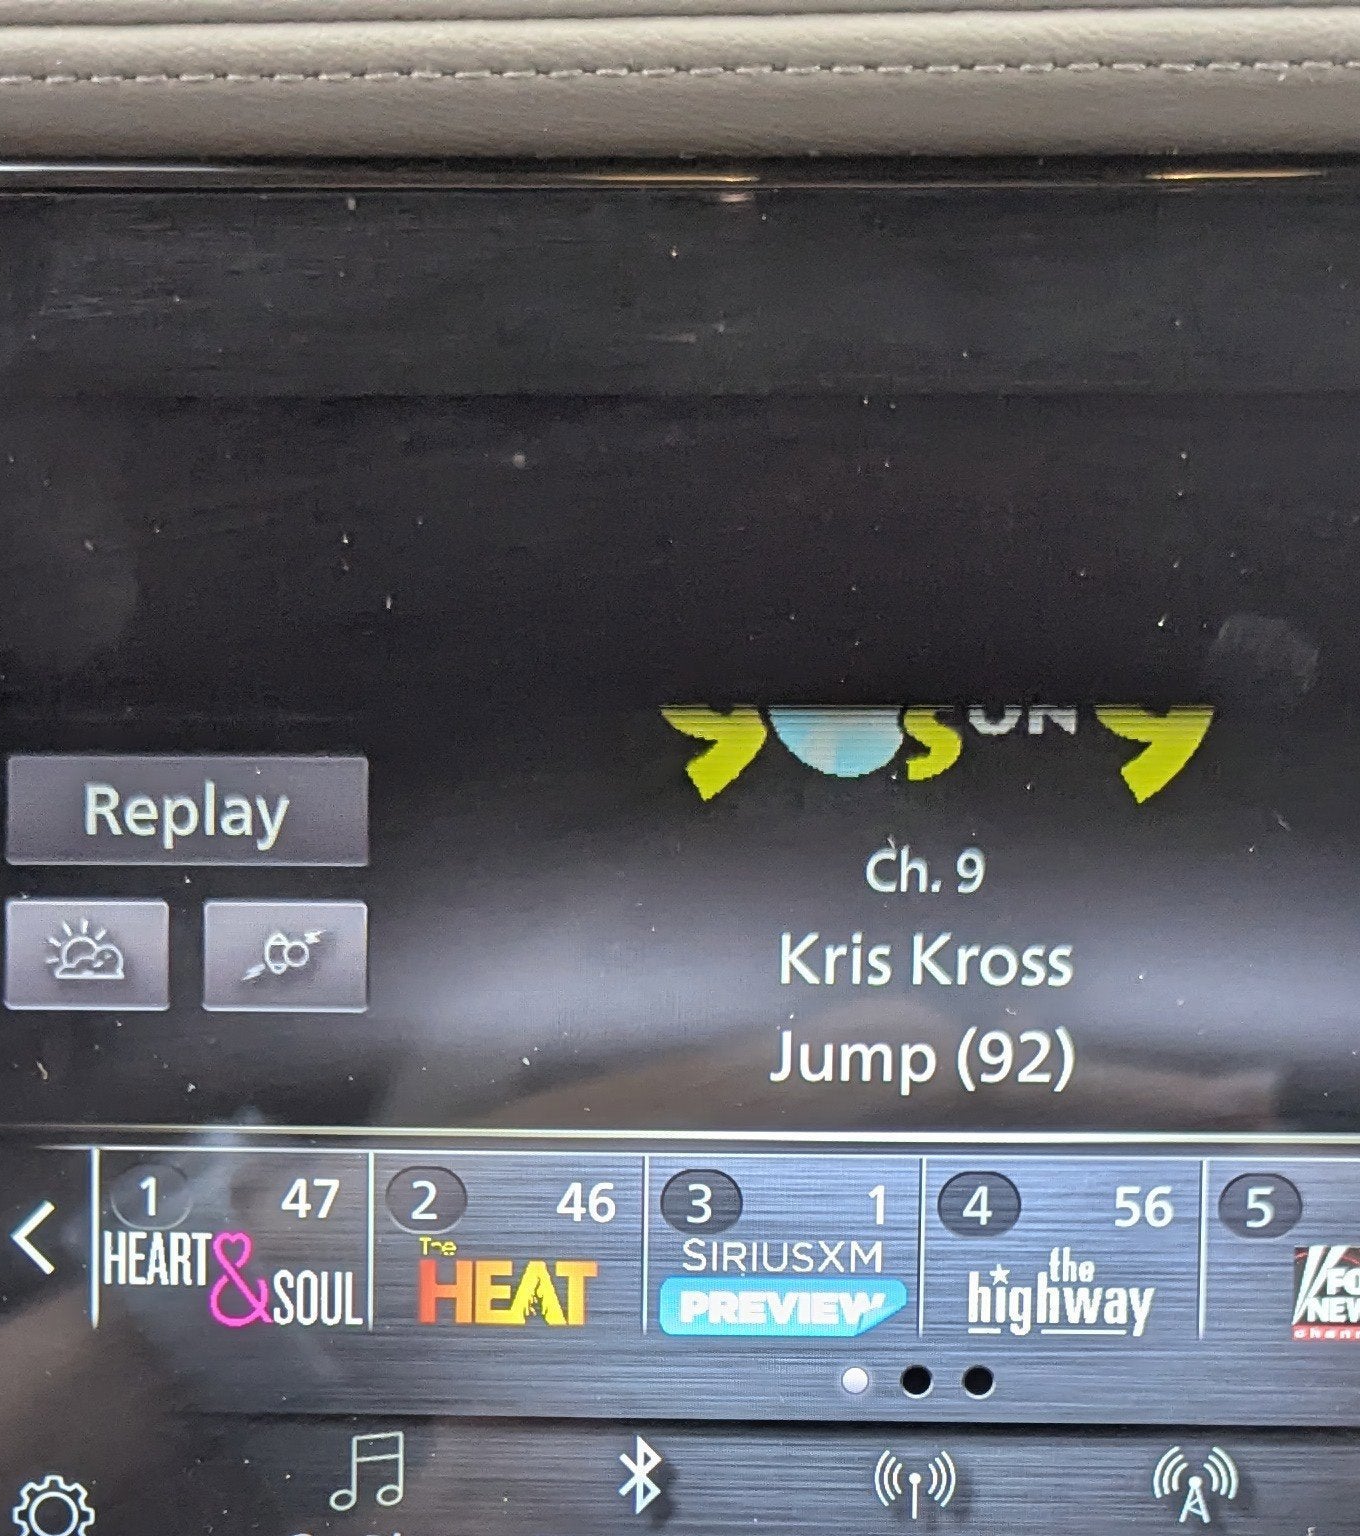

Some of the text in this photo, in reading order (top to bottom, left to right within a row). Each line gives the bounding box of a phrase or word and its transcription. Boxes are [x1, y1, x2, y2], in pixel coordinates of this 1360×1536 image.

[83, 781, 290, 851] Replay
[866, 845, 987, 894] Ch. 9
[779, 931, 1074, 987] Kris Kross
[769, 1026, 1075, 1096] Jump (92)
[140, 1176, 157, 1216] 1
[281, 1178, 340, 1219] 47
[411, 1179, 439, 1221] 2
[556, 1182, 616, 1223] 46
[685, 1183, 713, 1225] 3
[868, 1185, 886, 1226] 1
[961, 1186, 993, 1226] 4
[1114, 1185, 1174, 1228] 56
[1246, 1186, 1276, 1229] 5
[102, 1230, 213, 1287] HEART
[681, 1237, 884, 1274] SIRIUSXM
[1048, 1246, 1096, 1284] the
[273, 1269, 364, 1326] SOUL
[418, 1259, 600, 1327] HEAT
[678, 1290, 887, 1325] PREVIEW
[966, 1263, 1156, 1336] highway
